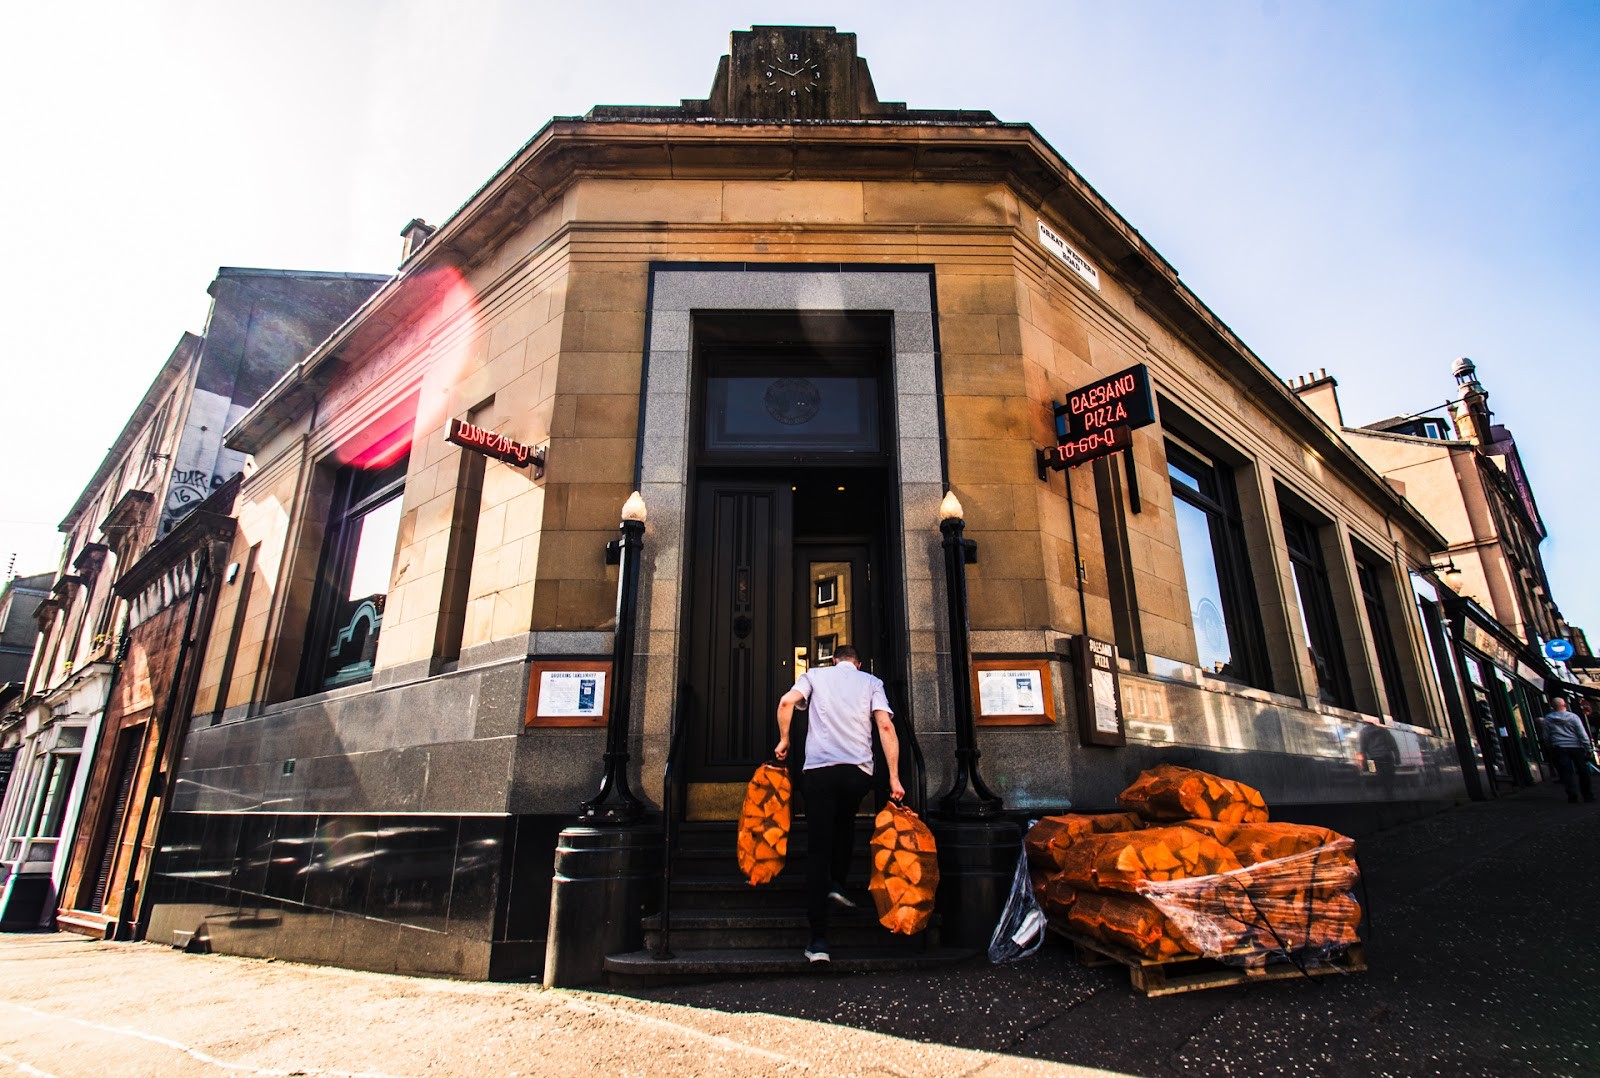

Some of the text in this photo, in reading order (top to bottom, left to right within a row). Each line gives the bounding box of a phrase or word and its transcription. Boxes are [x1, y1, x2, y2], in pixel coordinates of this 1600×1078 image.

[789, 53, 799, 61] 12
[815, 71, 821, 79] 3
[790, 88, 797, 96] 6
[1040, 225, 1097, 277] GREAT WESTERN
[1062, 251, 1081, 271] ROAD
[1070, 374, 1136, 415] PAESANO
[1084, 401, 1128, 431] PIZZA
[174, 489, 191, 503] 16
